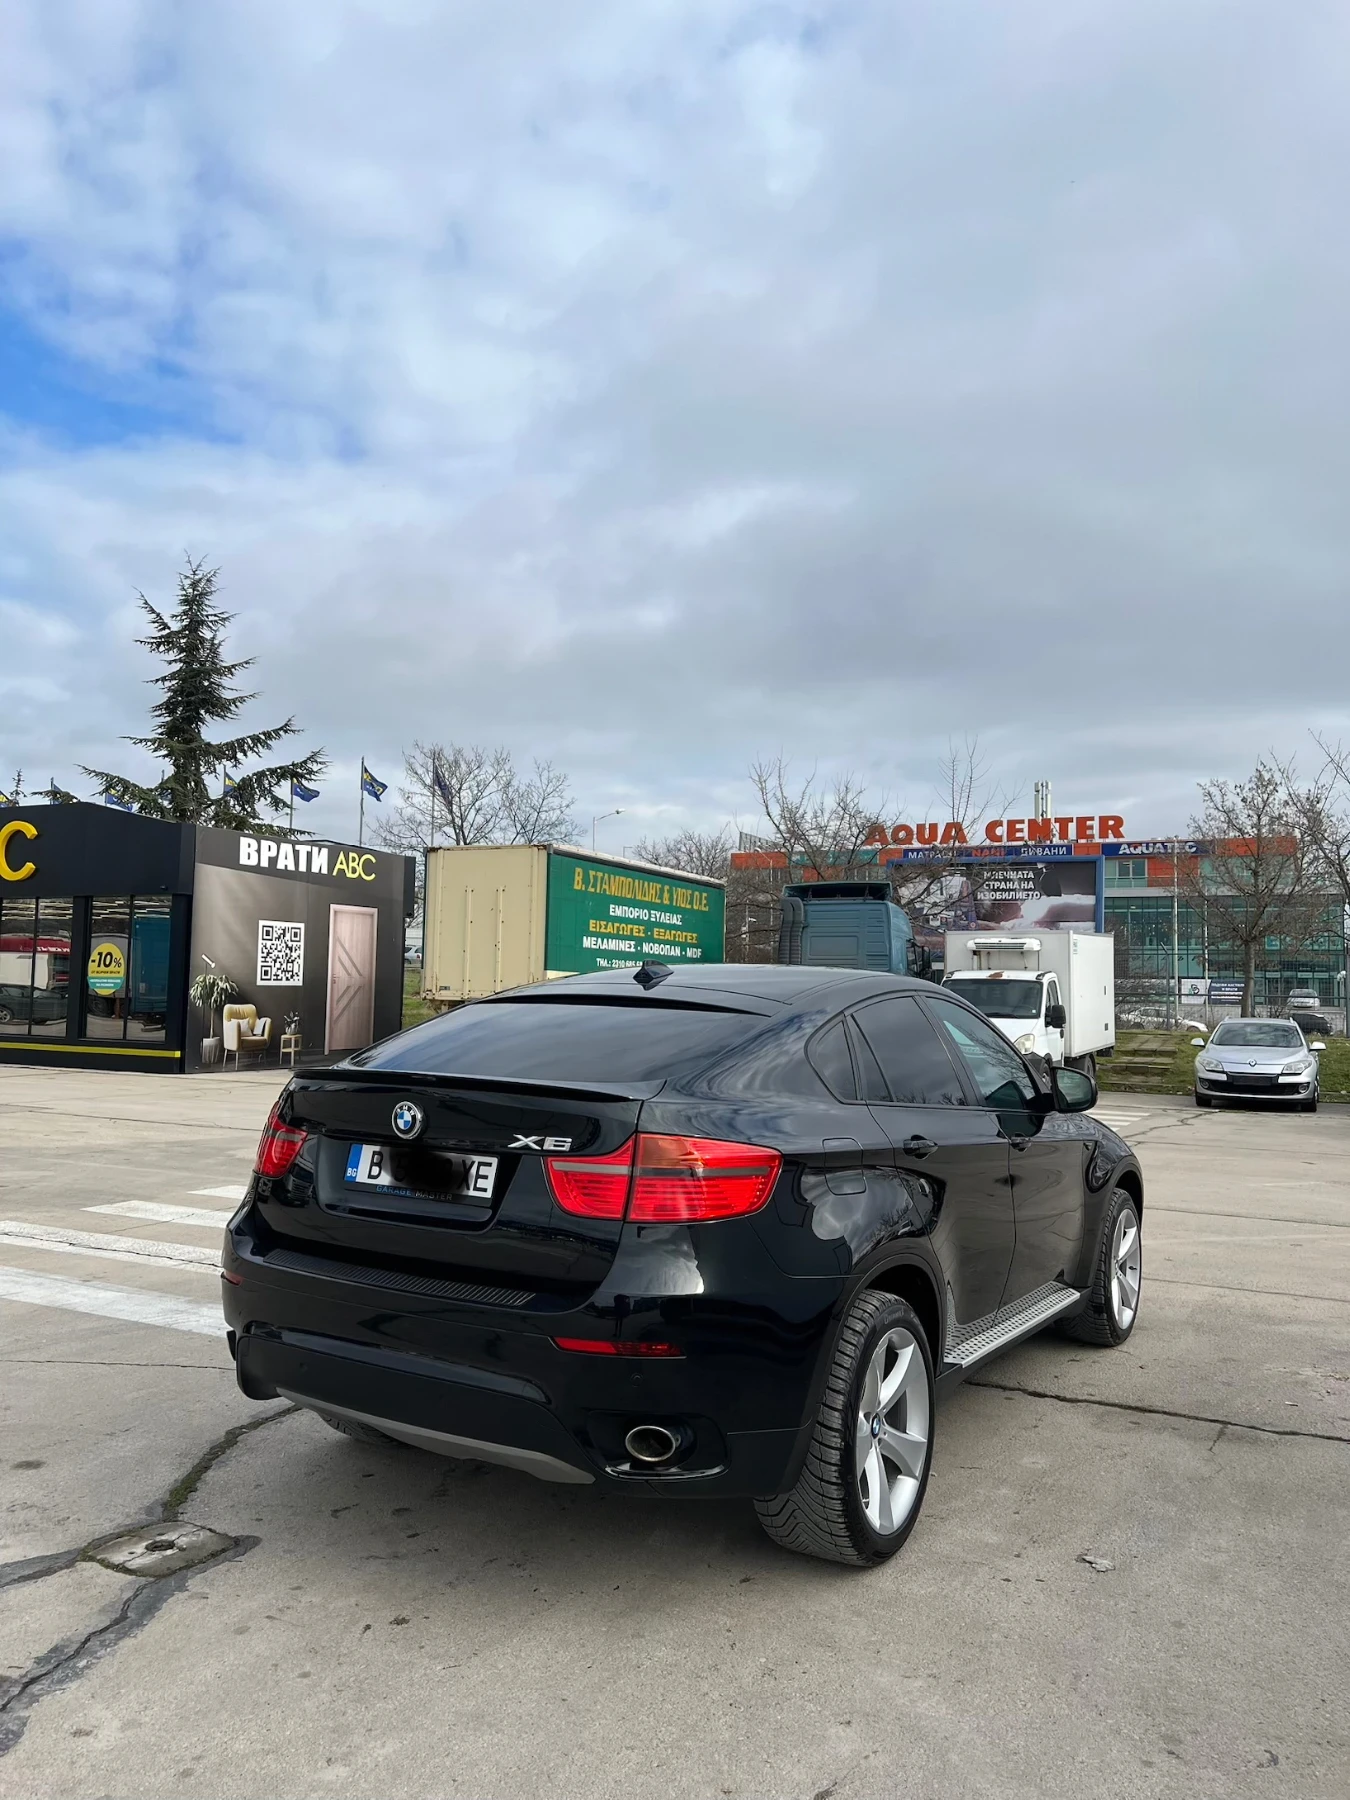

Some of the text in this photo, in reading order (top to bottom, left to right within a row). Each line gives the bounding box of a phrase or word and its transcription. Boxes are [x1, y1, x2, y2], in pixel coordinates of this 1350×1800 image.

[864, 815, 1125, 846] AQUA CENTER
[239, 836, 329, 874] ВРАТИ
[1021, 846, 1066, 857] ДИВАНИ
[1119, 842, 1197, 854] AQUATEC
[332, 850, 376, 881] ABC
[663, 885, 670, 905] &
[983, 881, 1034, 890] СТРАНА НА
[977, 891, 1041, 900] ИЗОБИЛИЕТО
[609, 904, 682, 925] ΕΜΠΟΡΙΟ ΞΥΛΕΙΑΣ
[589, 919, 645, 937] ΕΙΣΑΓΩΓΕΣ
[654, 928, 697, 943] ΕΞΑΓΩΓΕΣ
[583, 936, 635, 952] ΜΕΛΑΜΙΝΕΣ
[643, 942, 680, 957] ΝΟΒΟΠΑΝ
[687, 947, 702, 958] MDF
[91, 951, 122, 968] -10%
[508, 1133, 572, 1152] X6
[347, 1168, 357, 1177] BG
[376, 1185, 453, 1201] GARAGE MASTER
